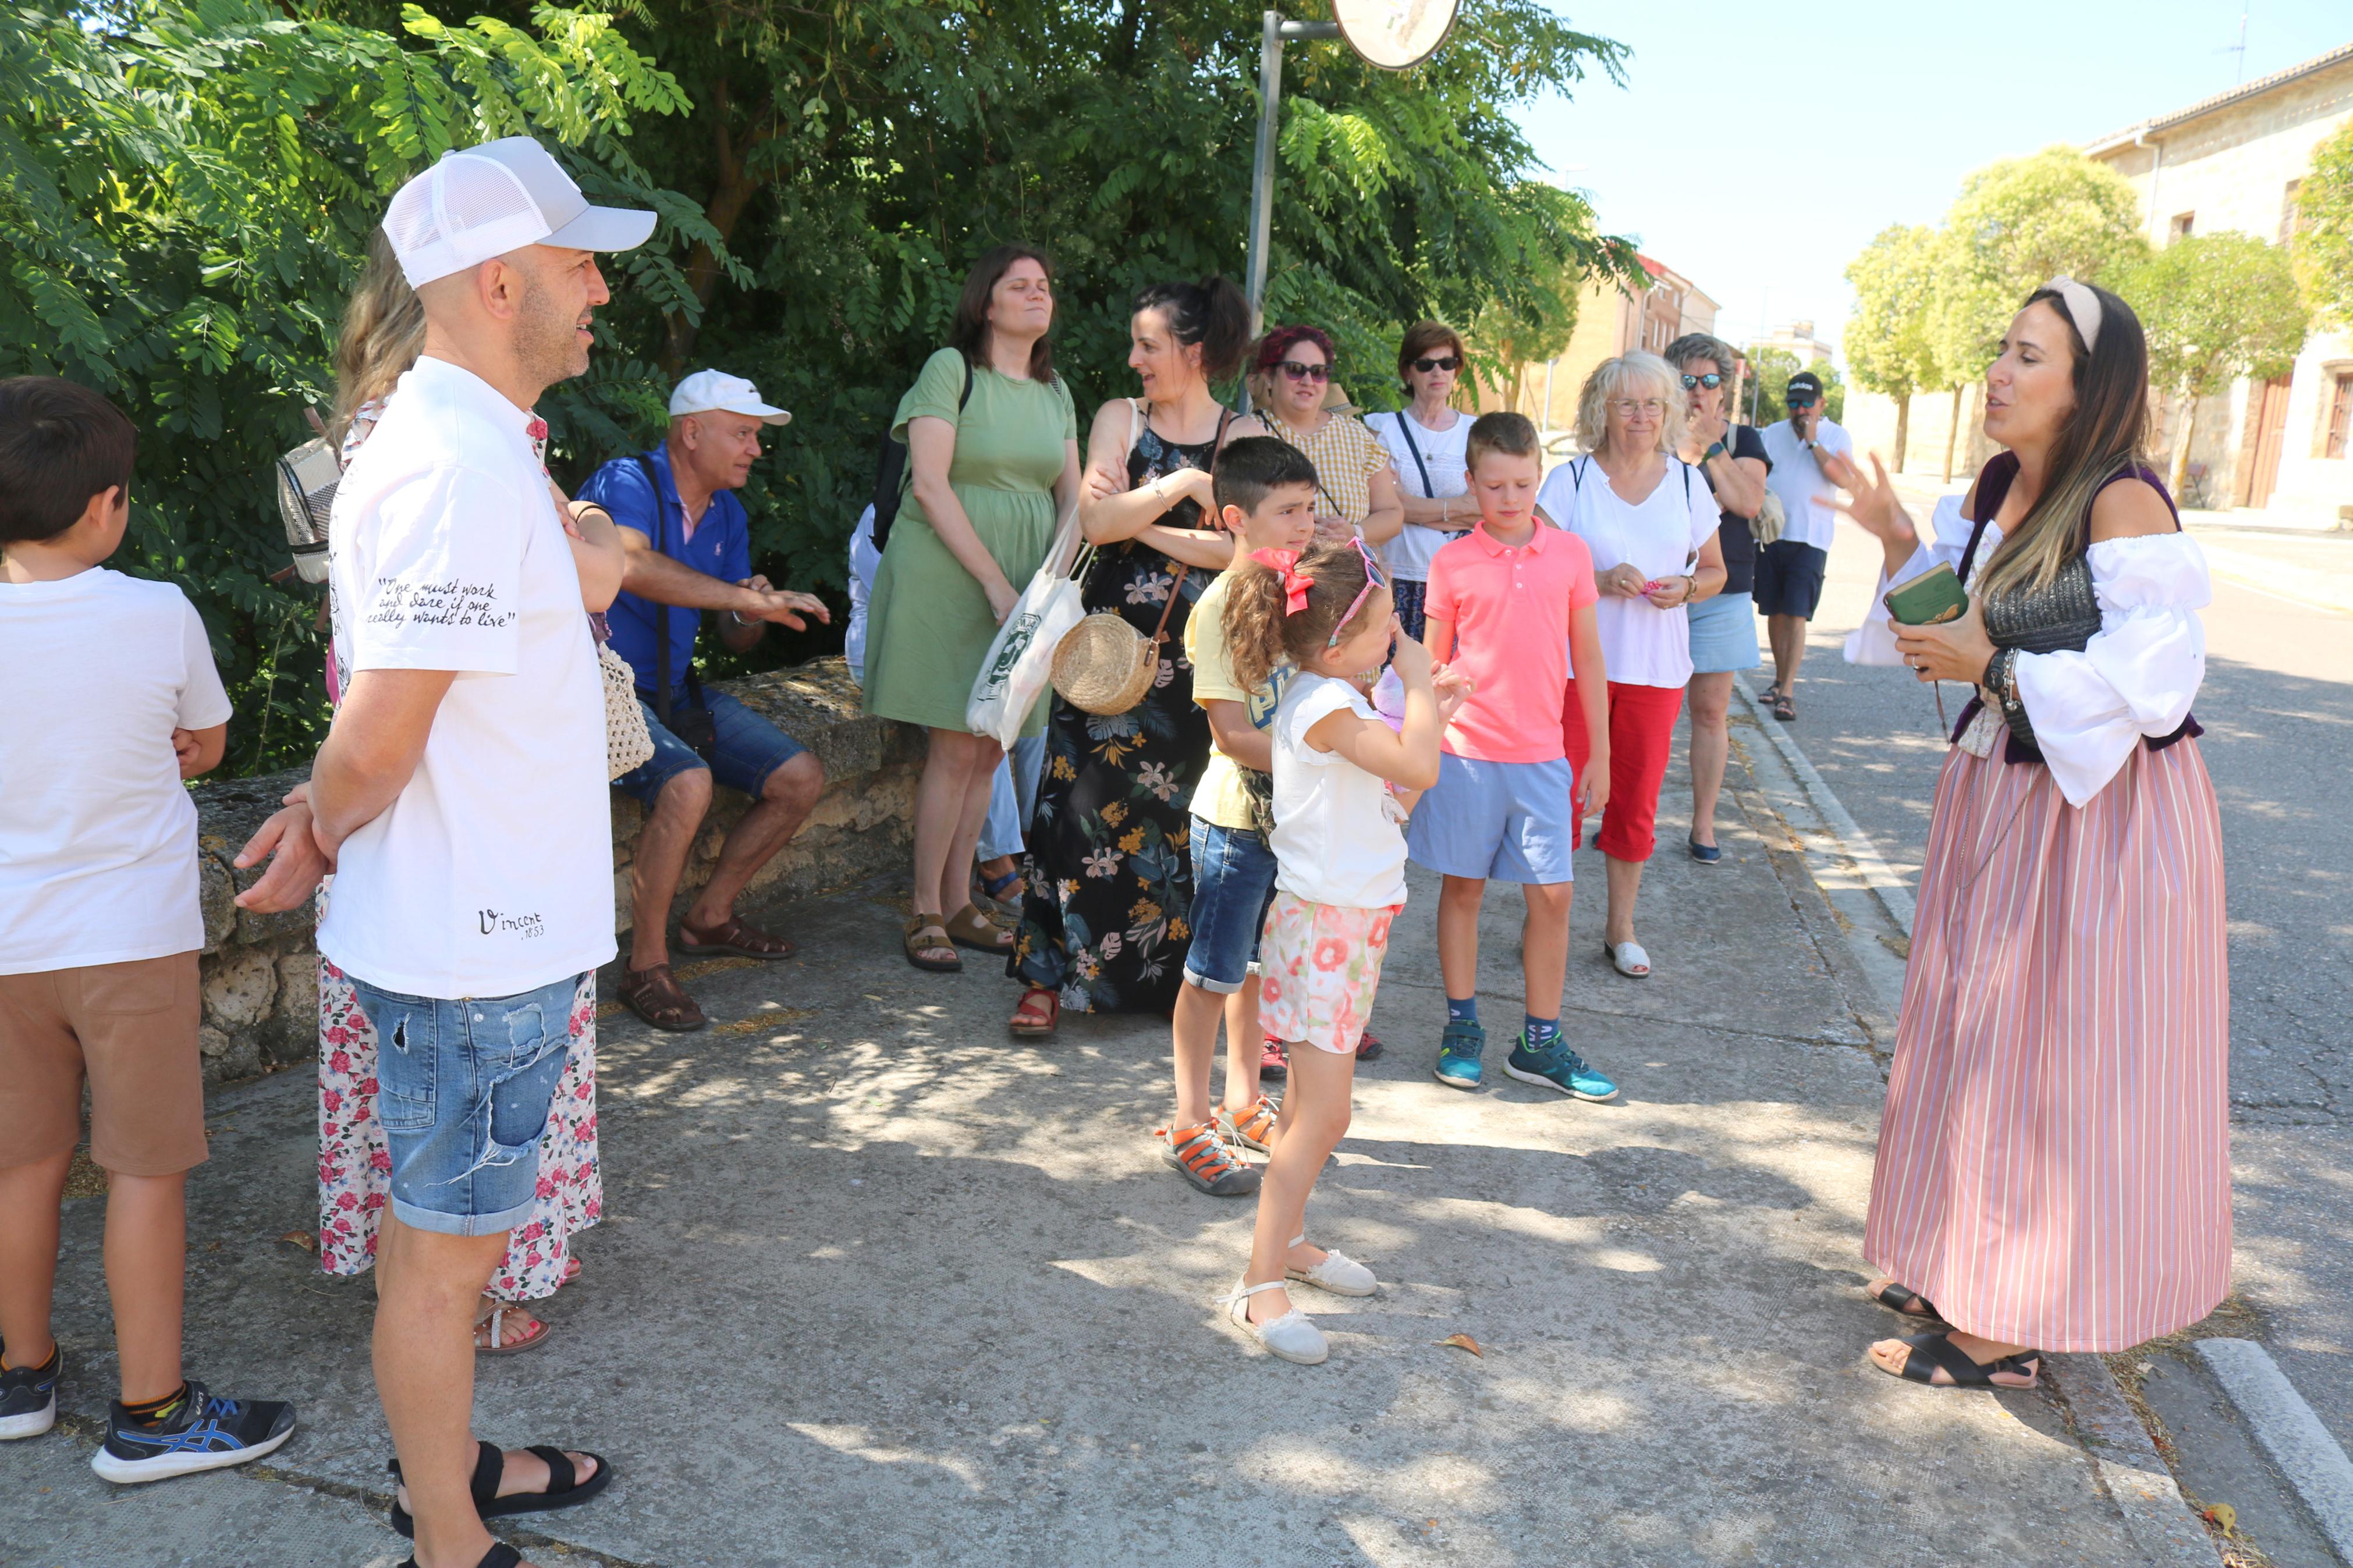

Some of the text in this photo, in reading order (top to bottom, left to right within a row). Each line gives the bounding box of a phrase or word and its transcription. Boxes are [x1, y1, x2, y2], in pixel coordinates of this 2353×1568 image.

[419, 578, 457, 594] must
[462, 584, 498, 599] work
[379, 592, 492, 616] and dare if one
[365, 609, 407, 628] really
[413, 608, 455, 625] wants
[459, 609, 471, 625] to
[478, 909, 541, 935] Vincent
